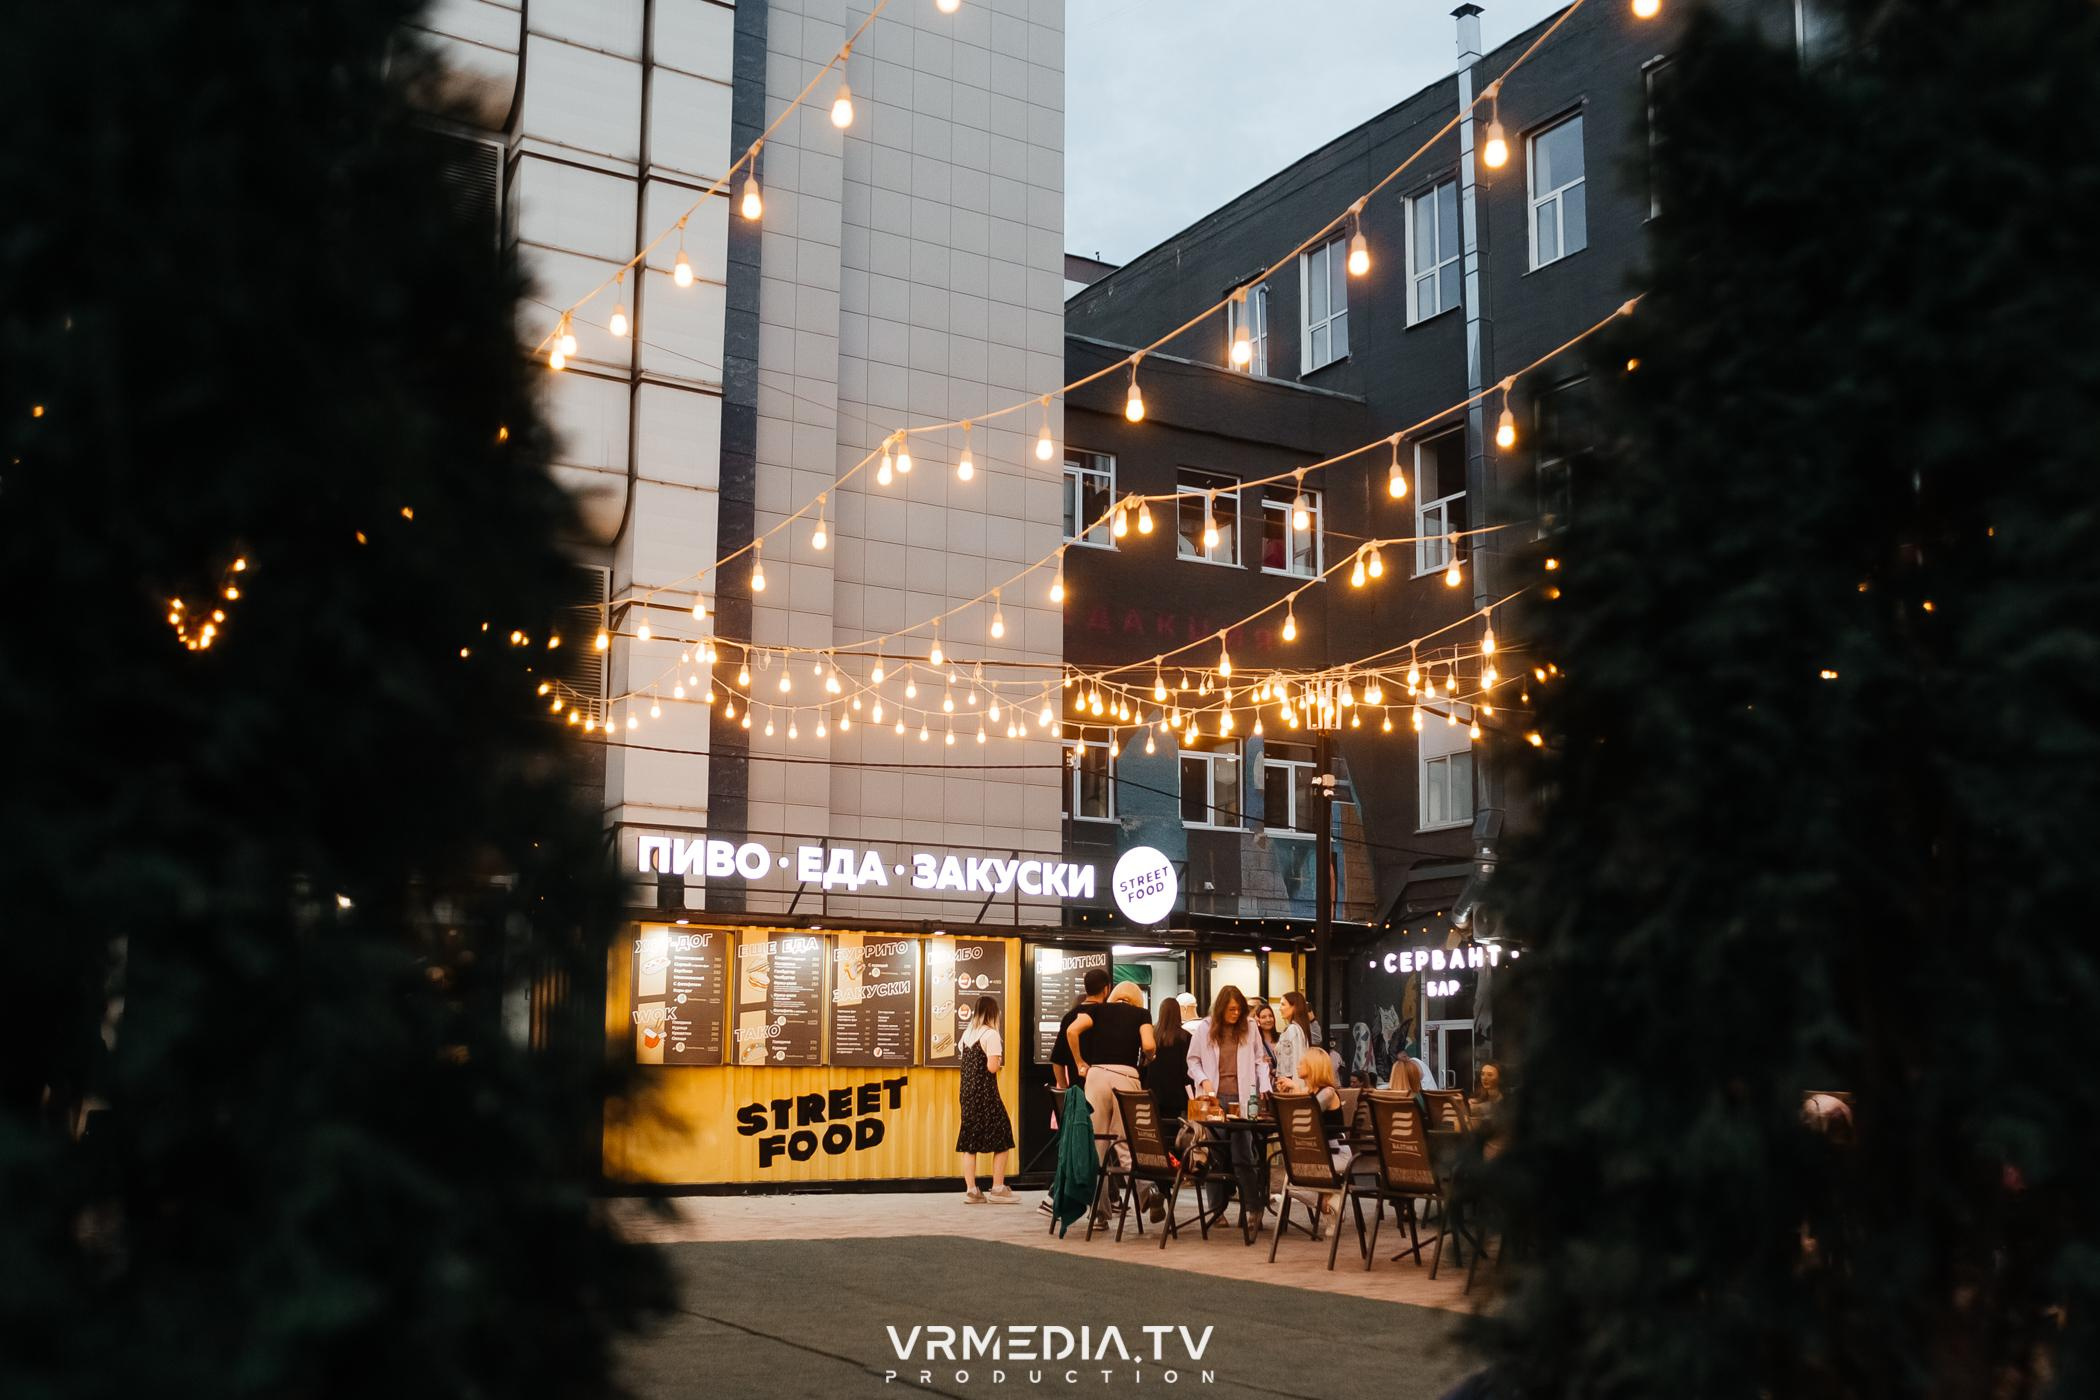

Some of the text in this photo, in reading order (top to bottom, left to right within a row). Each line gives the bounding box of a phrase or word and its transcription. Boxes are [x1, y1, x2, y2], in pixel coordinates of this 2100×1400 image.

[638, 835, 1095, 898] ПИВО ЕДА ЗАКУСКИ
[1119, 866, 1170, 893] STREET
[1127, 881, 1165, 904] FOOD
[634, 933, 713, 954] Х-ДОГ
[781, 937, 818, 954] ЕДА
[833, 941, 909, 962] БУРРИТО
[927, 946, 984, 966] МБО
[1036, 953, 1107, 975] НПИТКИ
[1383, 945, 1502, 974] СЕРВАНТ
[832, 980, 911, 1003] ЗАКУСКИ
[1426, 980, 1461, 997] БАР
[632, 1007, 677, 1025] WOK
[734, 1024, 782, 1043] ТАКО
[736, 1076, 908, 1136] STREET
[758, 1117, 885, 1168] FOOD
